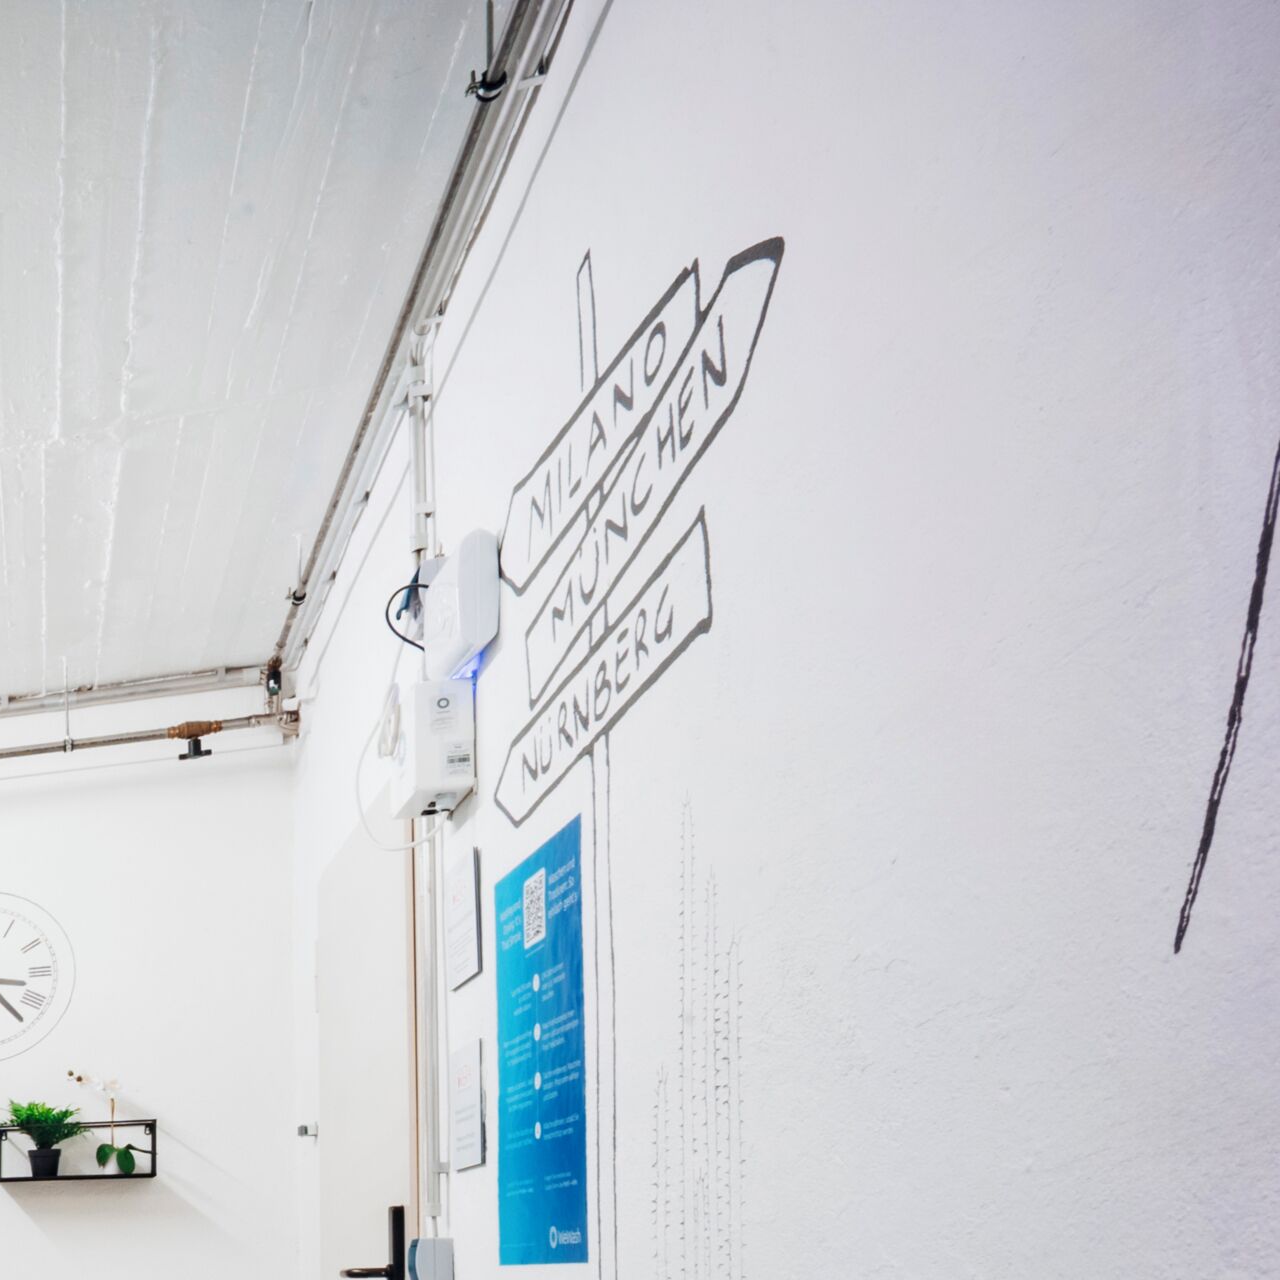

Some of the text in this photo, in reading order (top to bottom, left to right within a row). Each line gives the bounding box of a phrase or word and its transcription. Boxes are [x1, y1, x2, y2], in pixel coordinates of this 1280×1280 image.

[527, 319, 667, 562] MILANO
[549, 312, 729, 642] MÜNCHEN
[520, 583, 674, 794] NÜRNBERG
